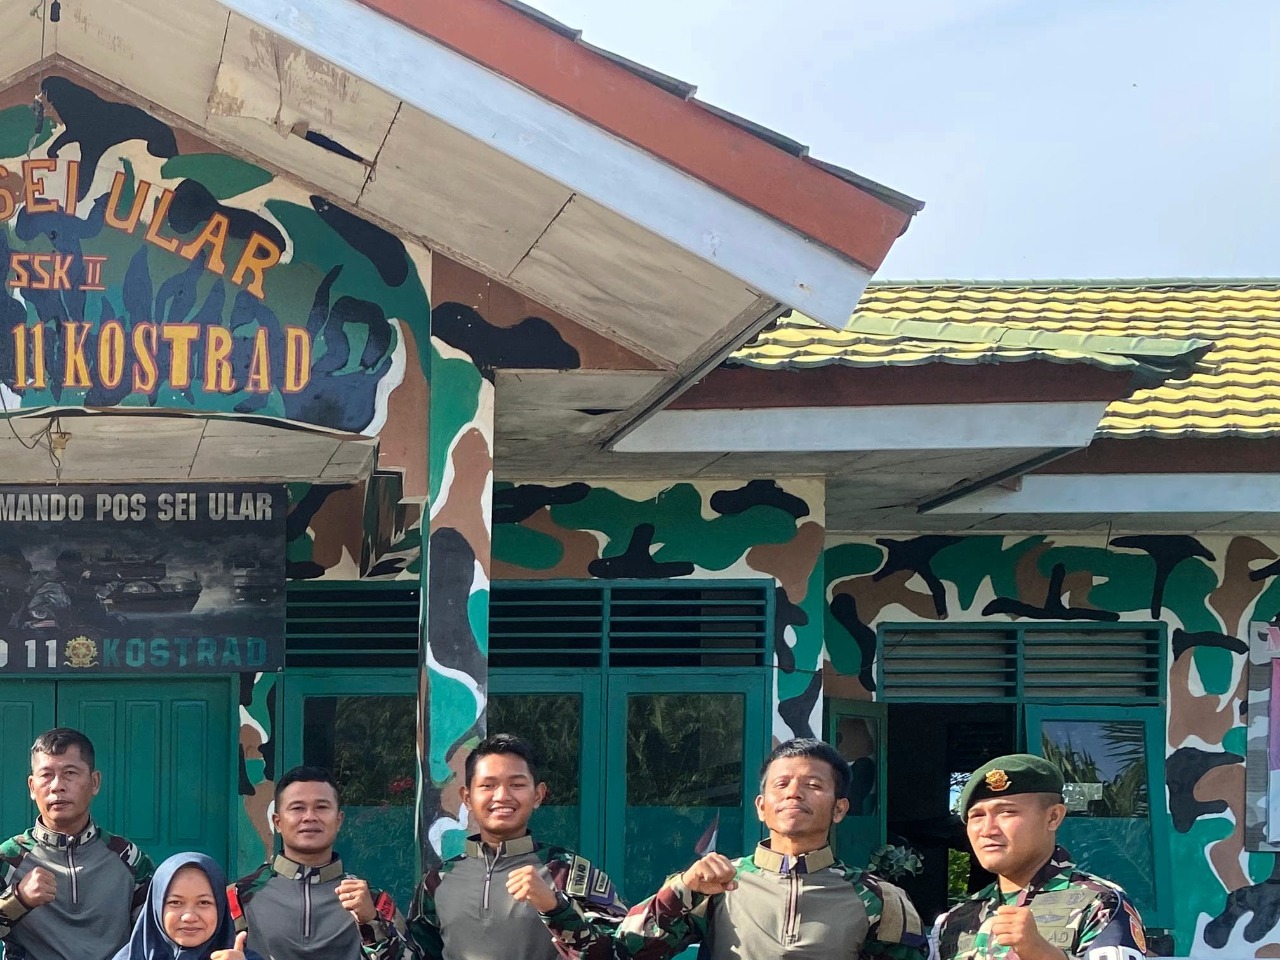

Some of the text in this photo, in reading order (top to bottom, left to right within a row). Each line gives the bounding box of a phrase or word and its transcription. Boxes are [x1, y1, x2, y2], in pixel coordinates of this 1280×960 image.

[103, 170, 283, 300] ULAR
[8, 253, 71, 290] SSK
[11, 323, 45, 392] 11
[63, 319, 314, 395] KOSTRAD
[96, 492, 146, 521] POS
[157, 492, 197, 521] SEI
[208, 491, 272, 521] ULAR
[24, 639, 57, 669] 11
[102, 636, 267, 668] KOSTRAD
